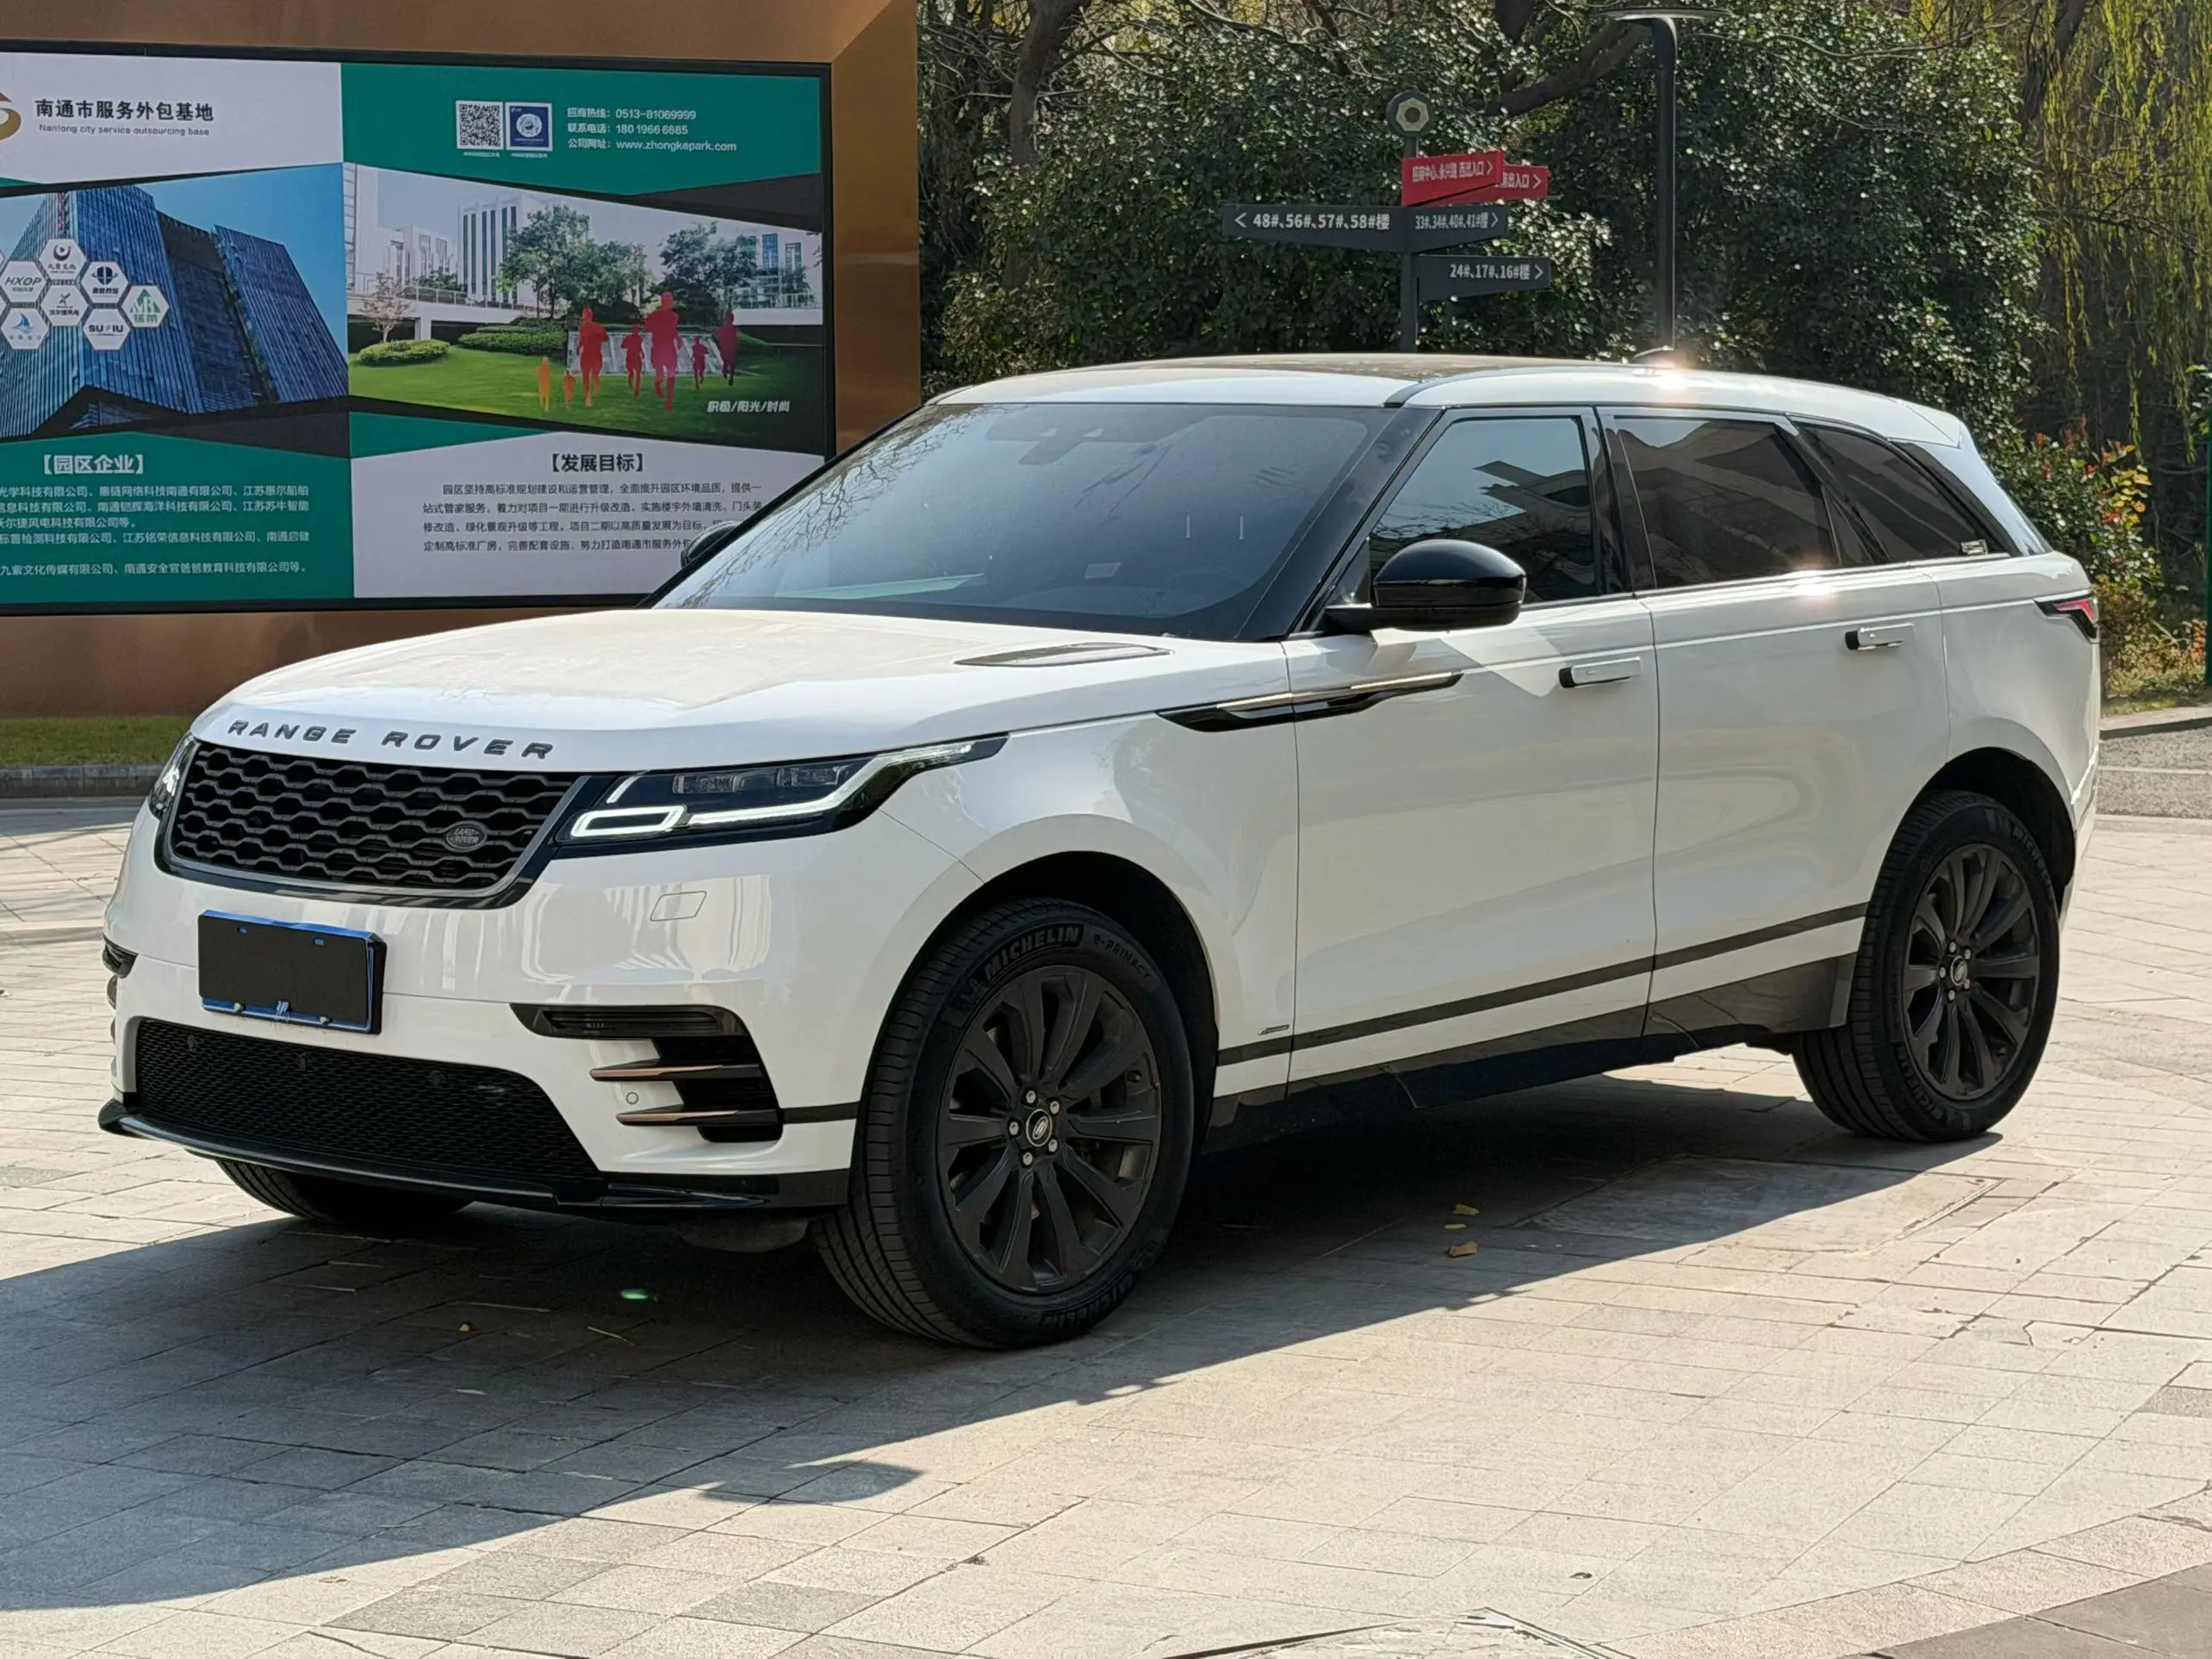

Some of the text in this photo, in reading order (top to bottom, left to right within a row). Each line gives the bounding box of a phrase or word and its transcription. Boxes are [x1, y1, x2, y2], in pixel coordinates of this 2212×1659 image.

[35, 98, 214, 121] 南通市服务外包基地
[80, 124, 96, 135] city
[98, 125, 131, 134] service
[134, 127, 185, 137] outsourcing
[615, 140, 737, 152] www.zhongkepark.com
[1252, 213, 1391, 231] 48#、56#、57#、58#楼
[227, 719, 555, 761] RANGE ROVER
[985, 926, 1079, 981] MICHELIN
